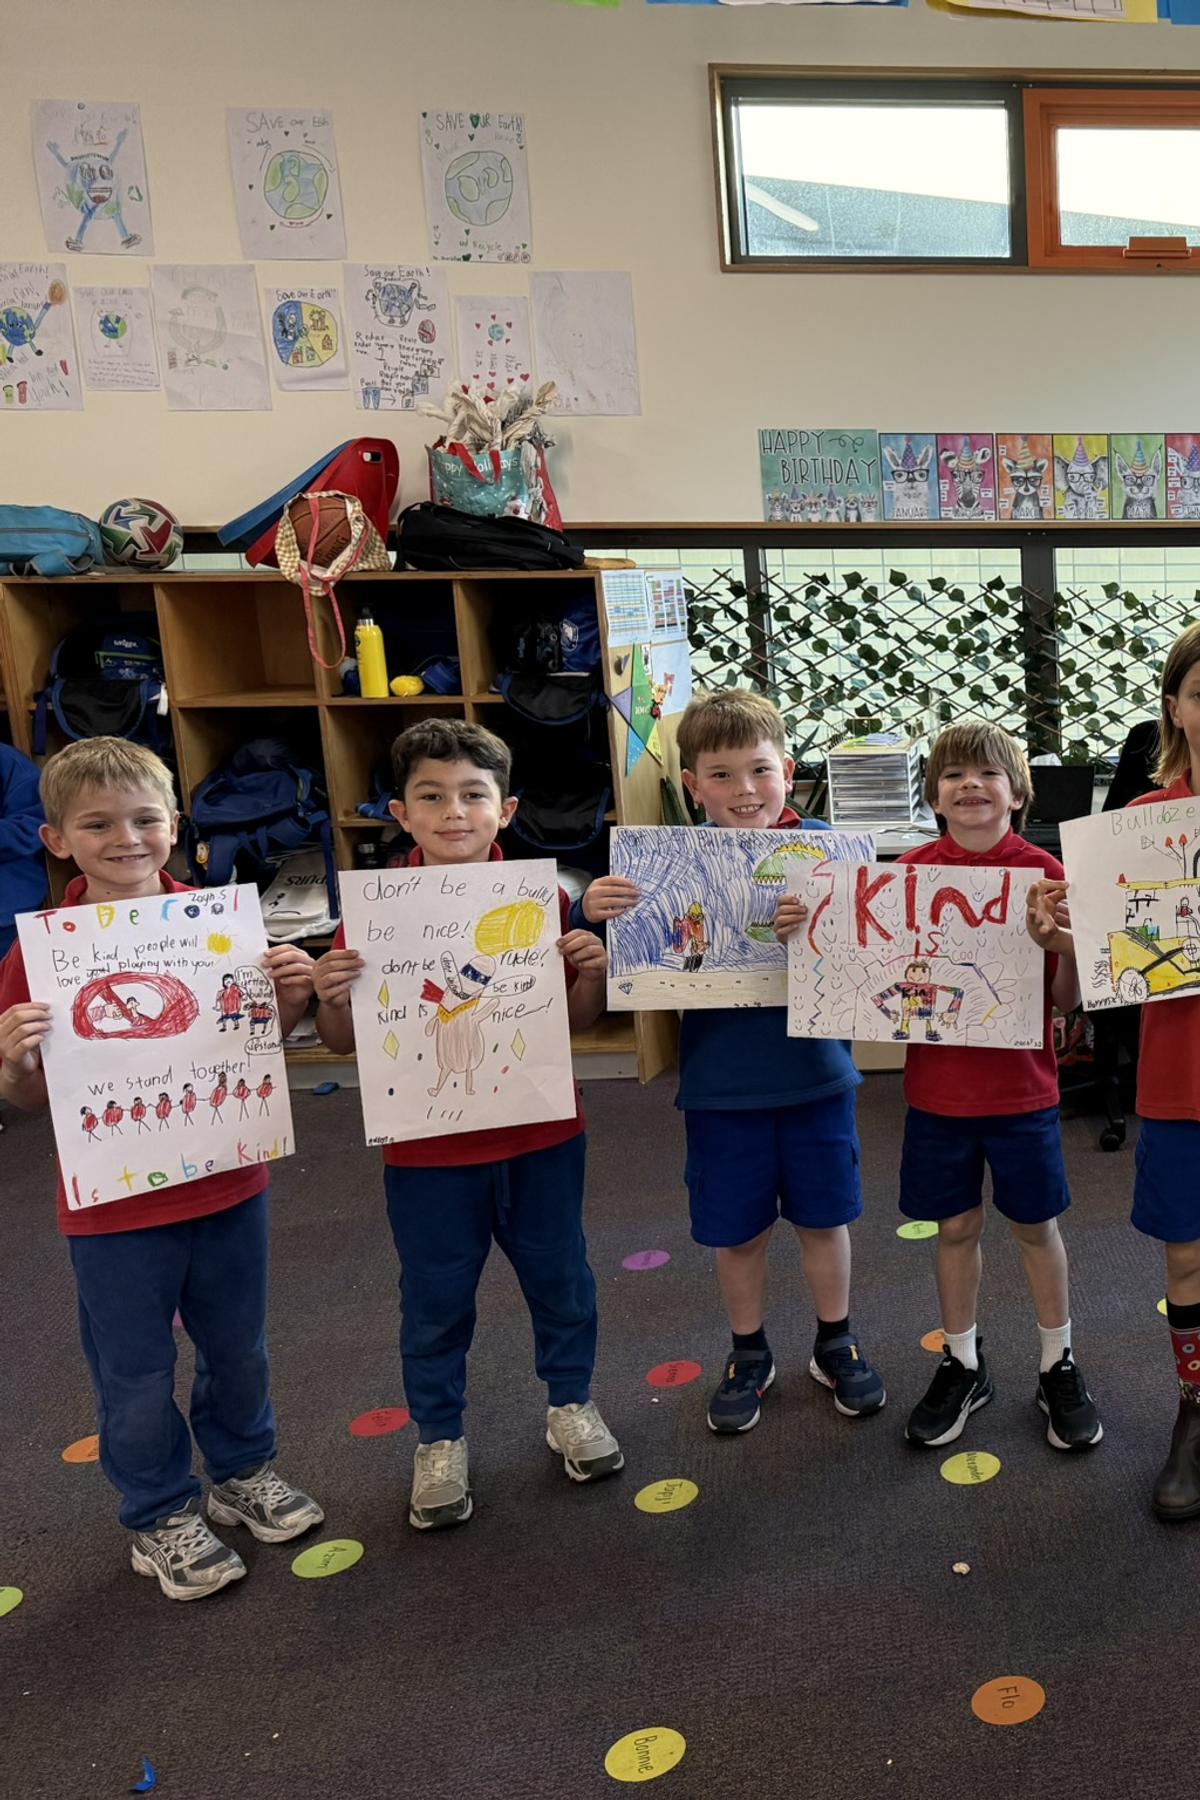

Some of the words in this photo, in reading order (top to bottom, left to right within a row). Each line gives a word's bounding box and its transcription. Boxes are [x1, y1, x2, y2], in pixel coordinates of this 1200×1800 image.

[436, 113, 464, 132] SAVE
[761, 431, 825, 456] HAPPY
[781, 458, 877, 485] BIRTHDAY
[1111, 805, 1197, 835] Bulldoze
[284, 874, 328, 886] PURS
[363, 875, 421, 902] don't
[440, 874, 467, 897] be
[492, 881, 504, 895] a
[516, 877, 555, 907] bully
[34, 909, 77, 935] To
[367, 920, 396, 942] be
[422, 920, 472, 940] nice!
[51, 949, 80, 973] Be
[134, 937, 176, 963] people
[179, 934, 199, 950] will
[421, 959, 436, 972] be
[56, 974, 81, 989] love
[118, 956, 161, 978] playing
[163, 955, 188, 969] with
[493, 983, 507, 994] be
[126, 1064, 174, 1090] stand
[189, 1054, 251, 1083] together!
[117, 1167, 168, 1192] to
[180, 1153, 215, 1177] be
[997, 1685, 1020, 1709] Flo
[634, 1735, 657, 1774] Bonnie
